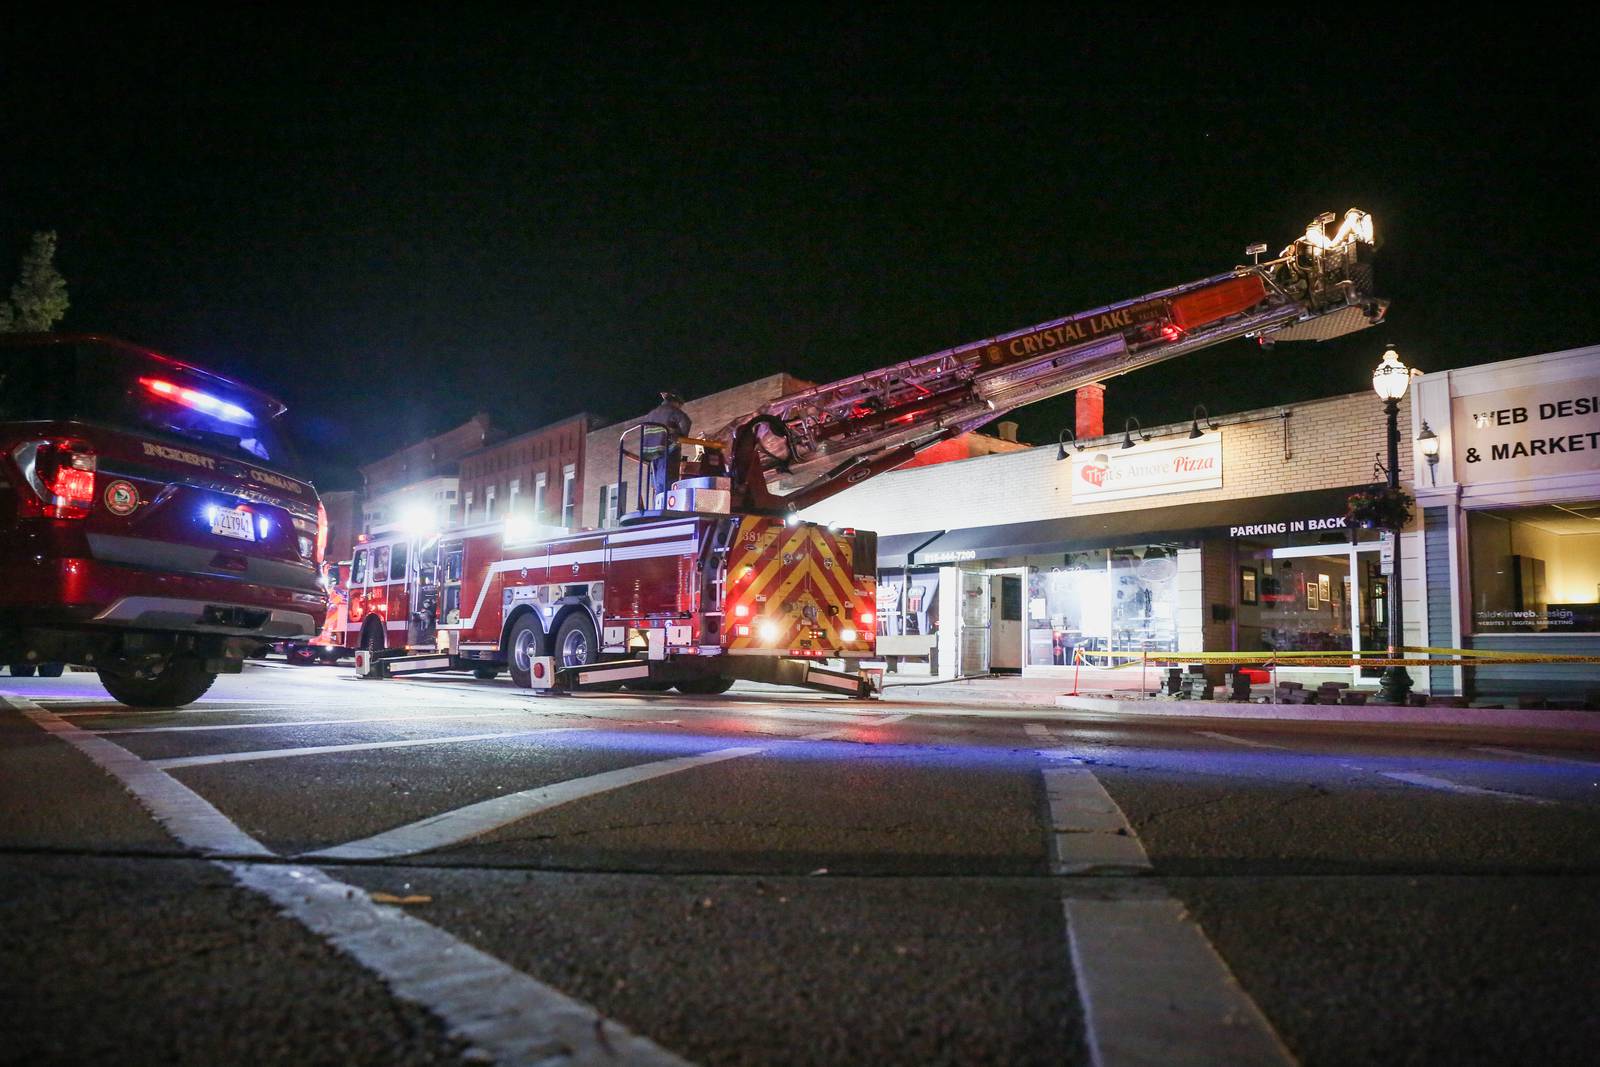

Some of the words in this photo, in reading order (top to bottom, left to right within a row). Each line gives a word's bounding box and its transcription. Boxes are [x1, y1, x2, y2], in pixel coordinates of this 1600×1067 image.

[1008, 323, 1087, 357] CRYSTAL
[1090, 308, 1133, 334] LAKE
[1539, 396, 1600, 421] DESI
[142, 441, 216, 470] INCIDENT
[1466, 447, 1481, 463] &
[1491, 432, 1600, 461] MARKET
[1086, 466, 1122, 483] That's
[1128, 462, 1170, 479] Amore
[1173, 455, 1214, 473] Pizza
[743, 531, 761, 542] 381
[1229, 522, 1287, 537] PARKING
[1290, 520, 1305, 533] IN
[1308, 516, 1347, 530] BACK
